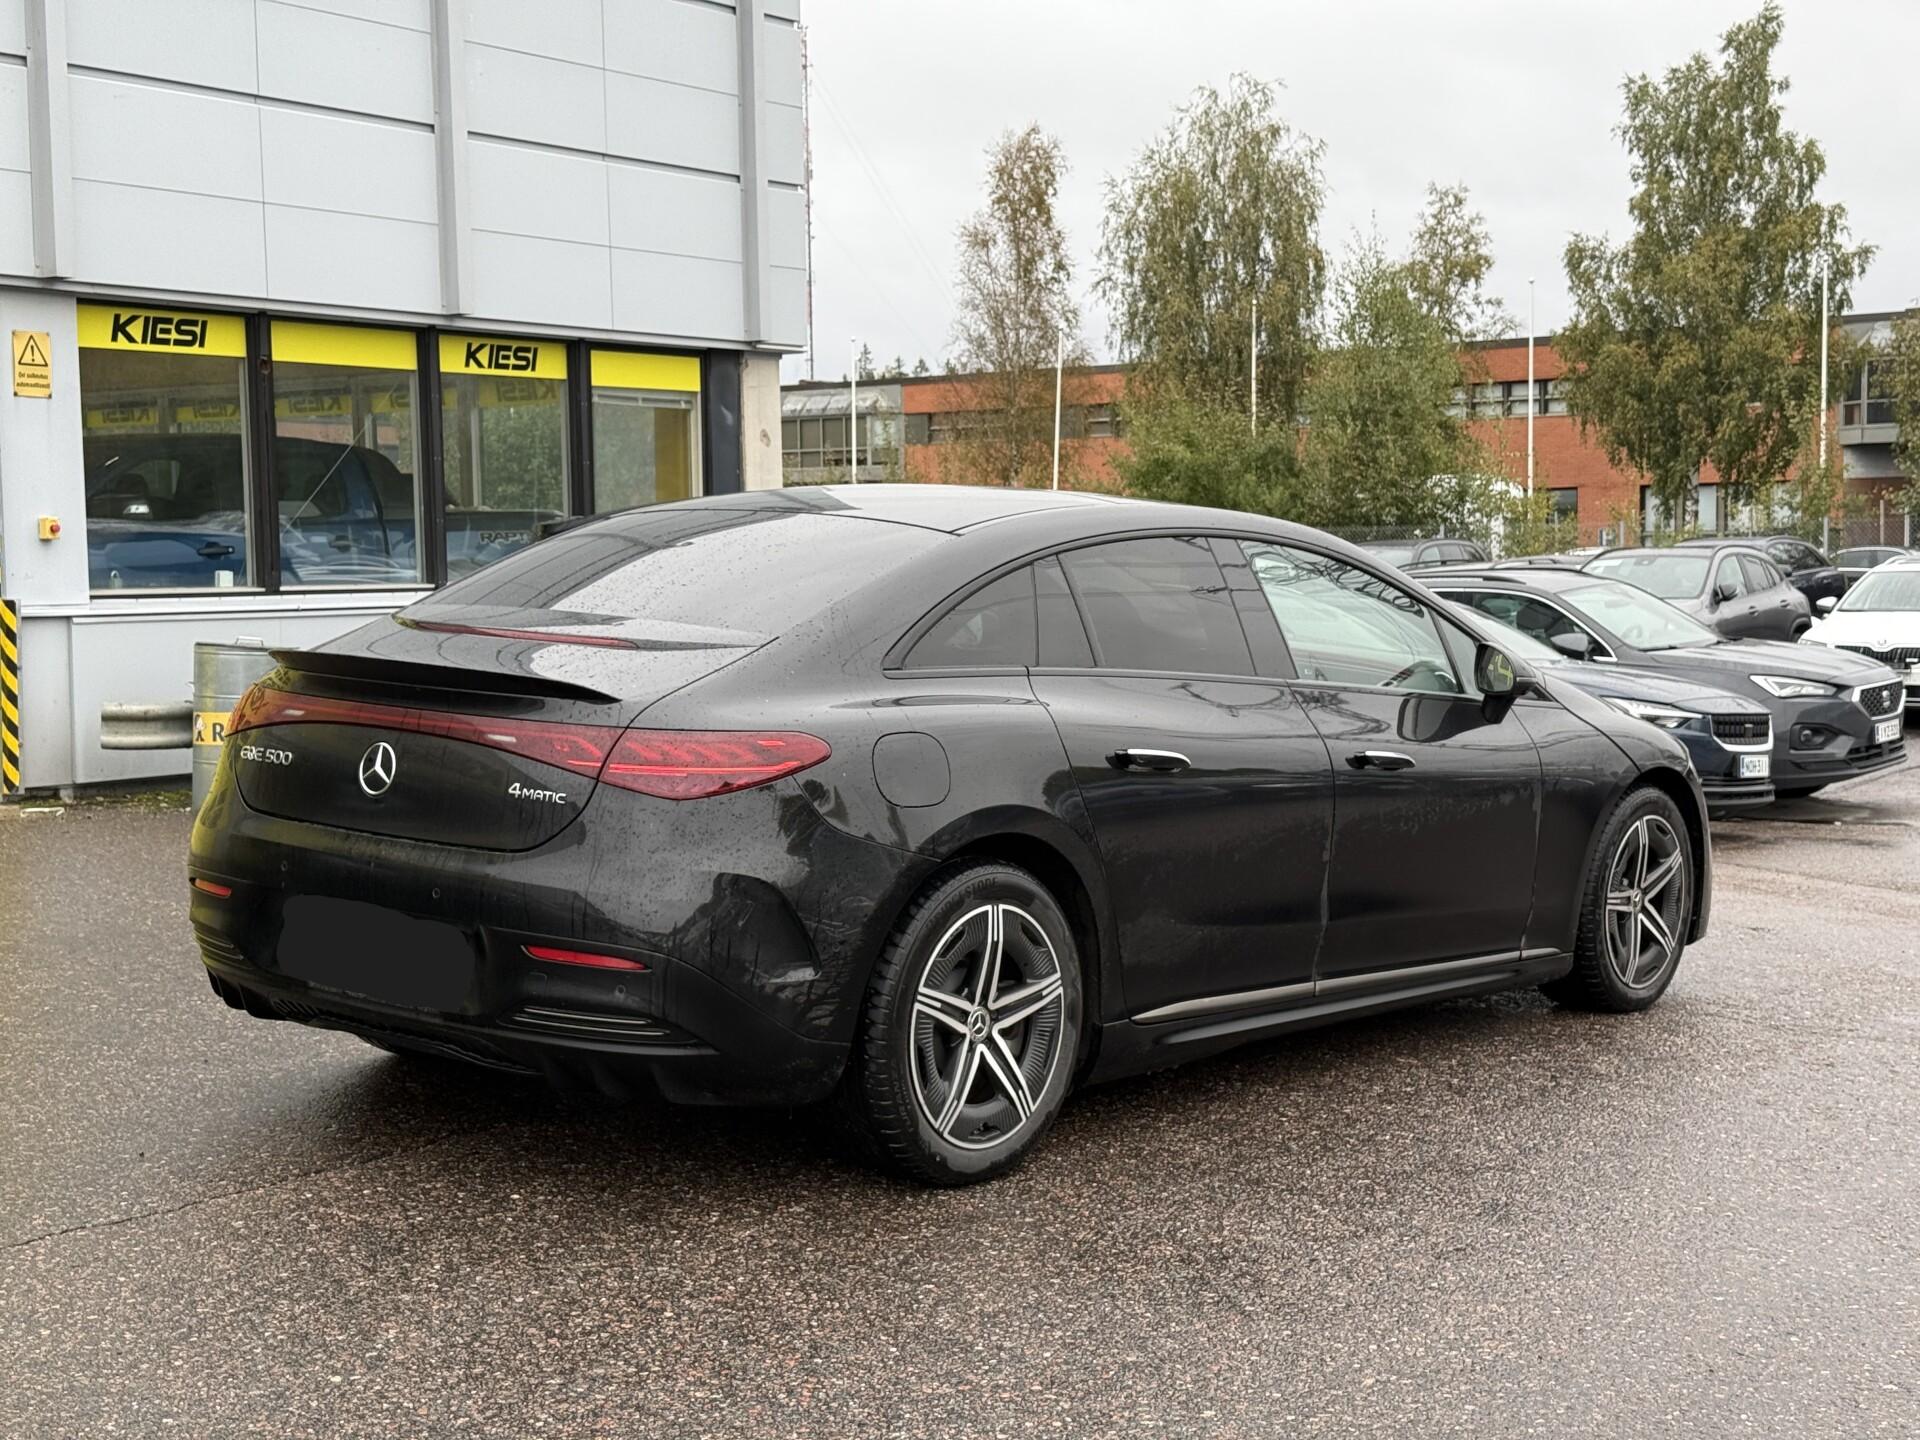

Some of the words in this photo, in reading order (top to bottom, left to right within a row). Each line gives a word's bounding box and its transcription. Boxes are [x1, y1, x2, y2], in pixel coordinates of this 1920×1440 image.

[111, 313, 208, 348] KIESI
[464, 342, 539, 372] KIESI
[480, 531, 531, 544] RAPT
[265, 749, 293, 766] 500
[508, 782, 567, 804] 4MATIC
